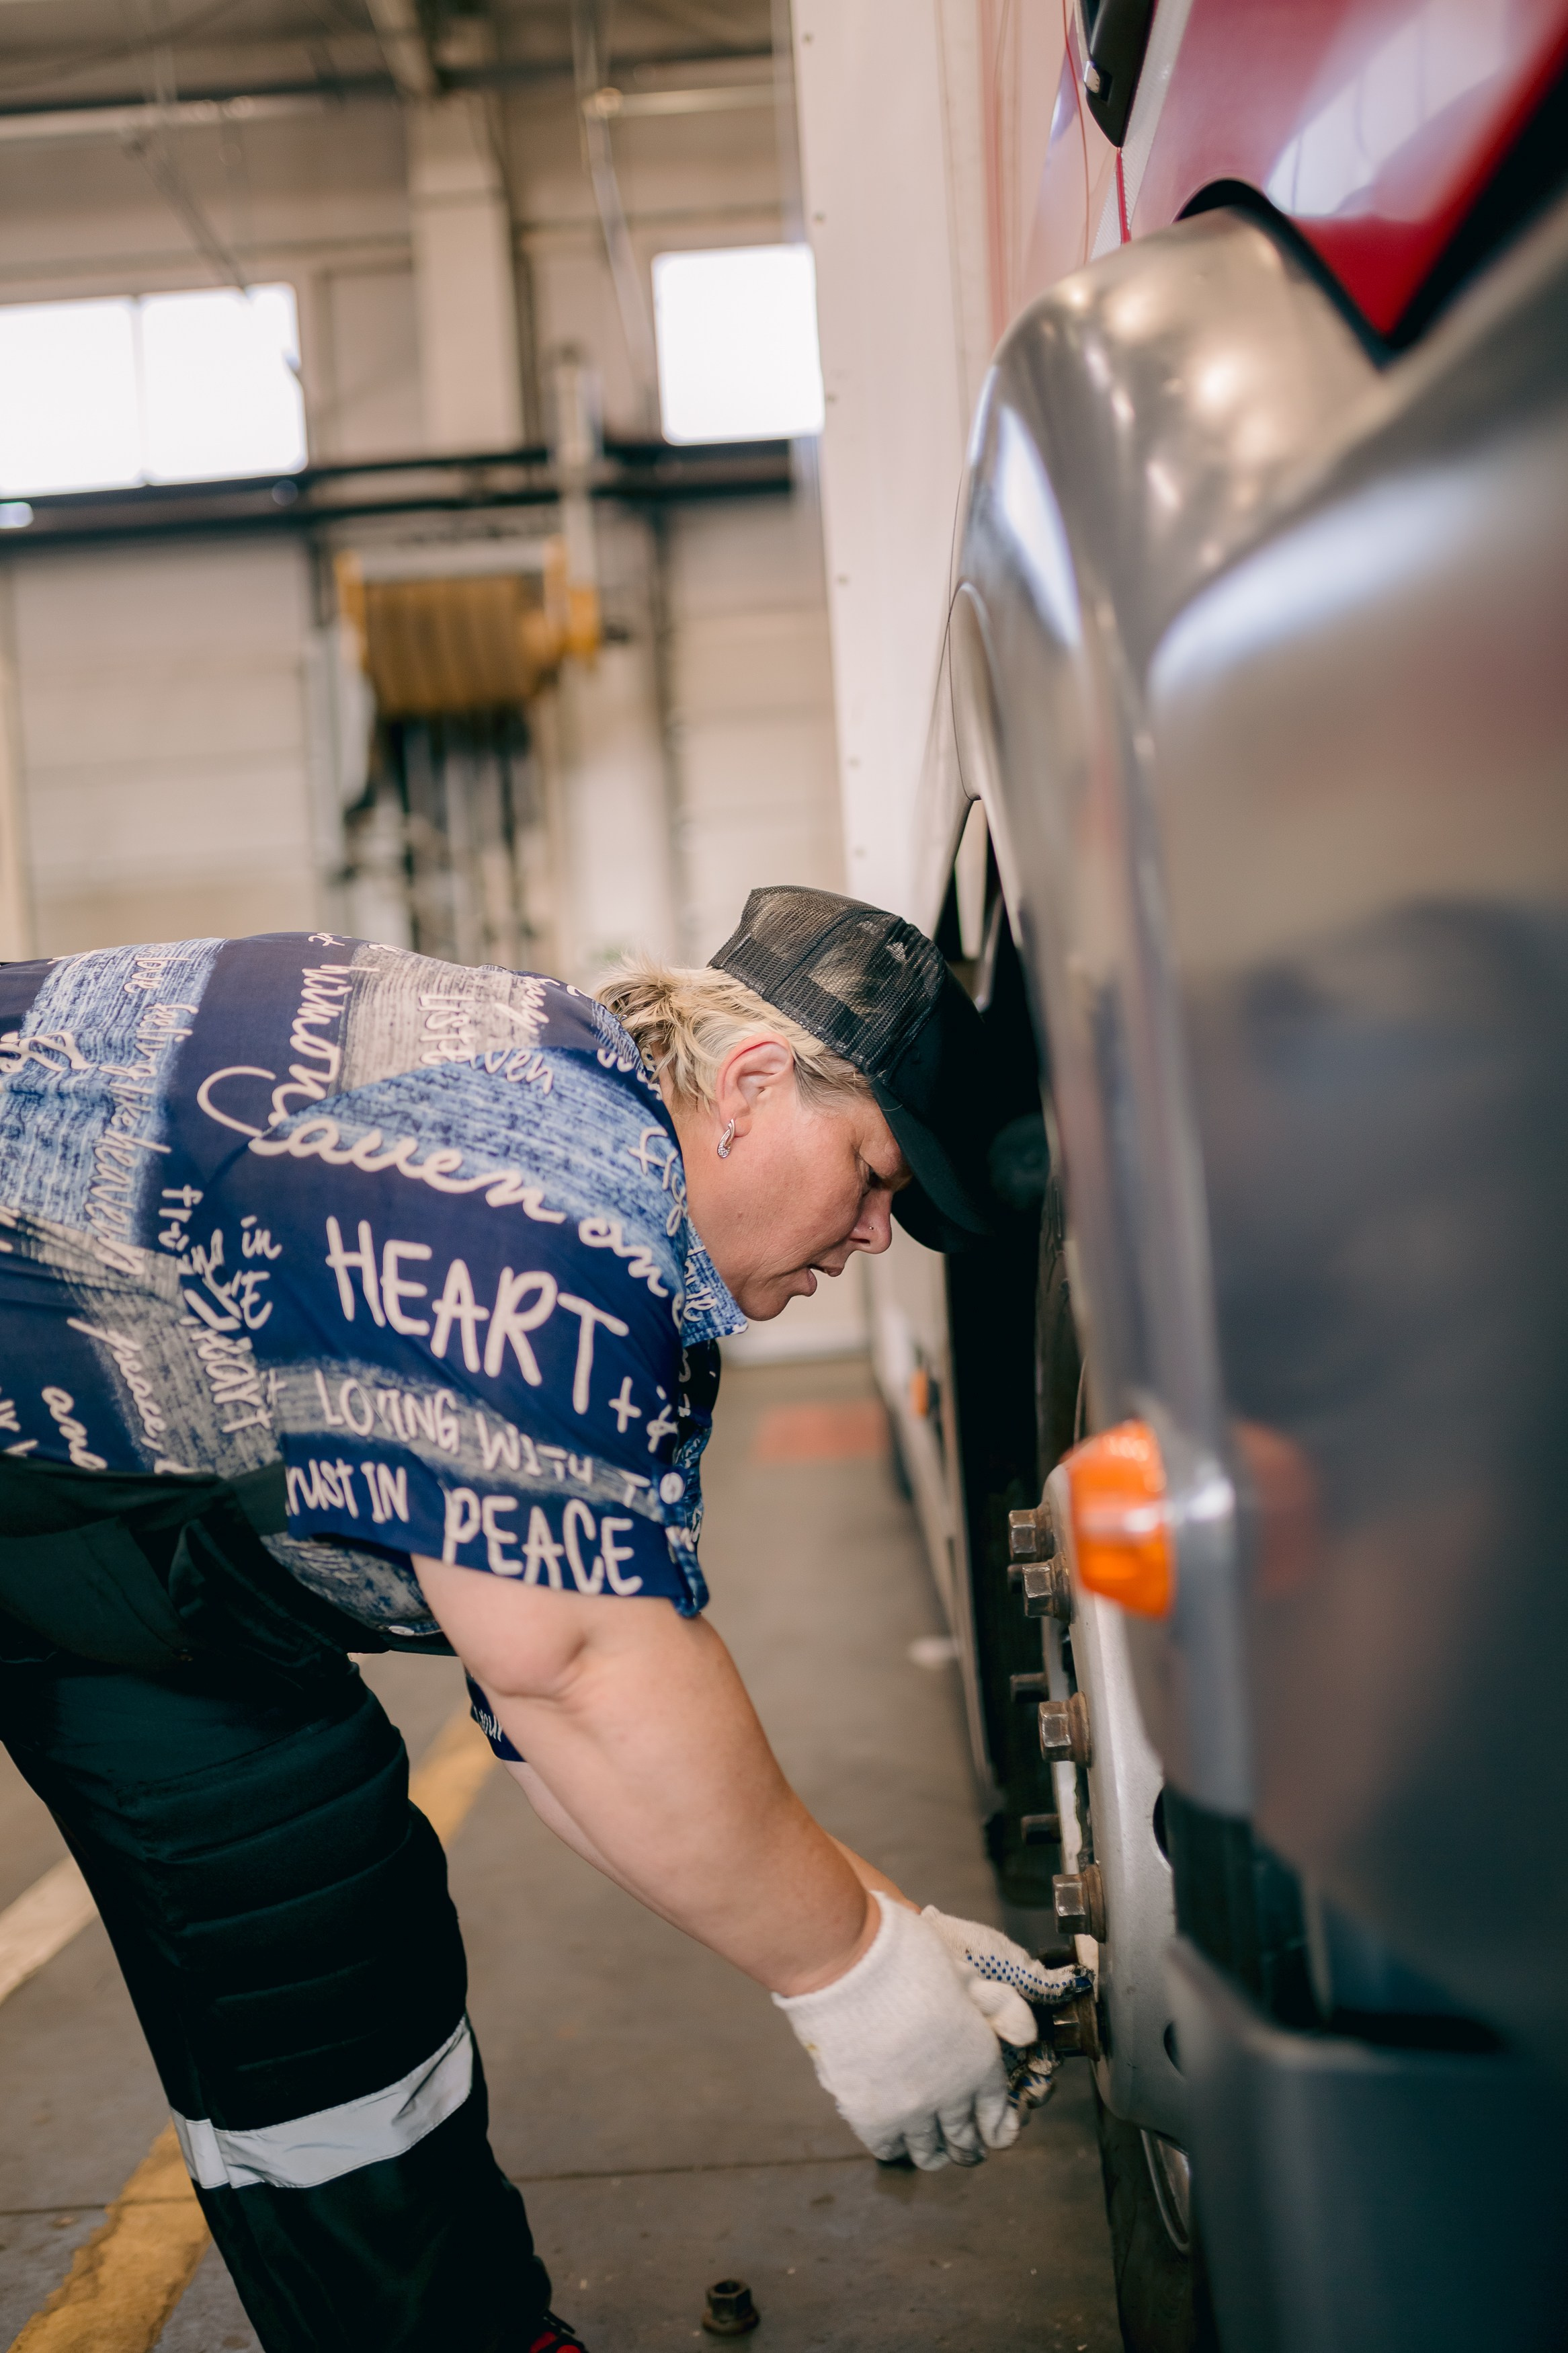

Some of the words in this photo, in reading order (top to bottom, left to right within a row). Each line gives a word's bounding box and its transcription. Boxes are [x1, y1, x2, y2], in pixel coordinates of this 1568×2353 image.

[326, 1216, 629, 1414] HEART
[360, 1460, 409, 1524] IN
[442, 1486, 643, 1596] PEACE
